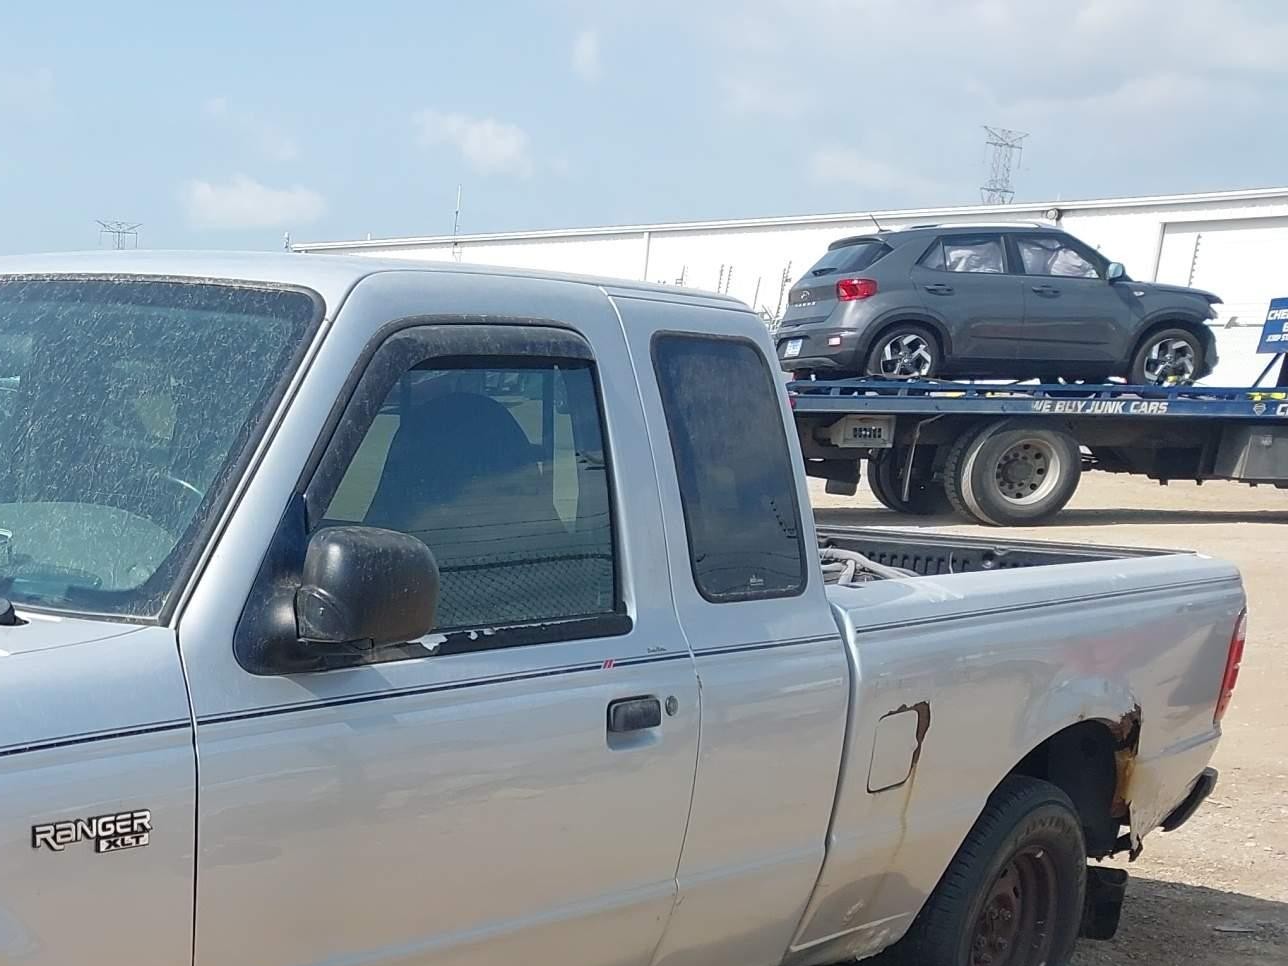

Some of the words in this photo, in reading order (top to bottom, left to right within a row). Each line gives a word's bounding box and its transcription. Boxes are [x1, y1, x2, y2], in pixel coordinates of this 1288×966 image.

[1032, 400, 1052, 412] WE
[1054, 400, 1086, 413] BUY
[1086, 400, 1125, 414] JUNK
[1129, 401, 1169, 414] CARS
[102, 834, 148, 851] XLT
